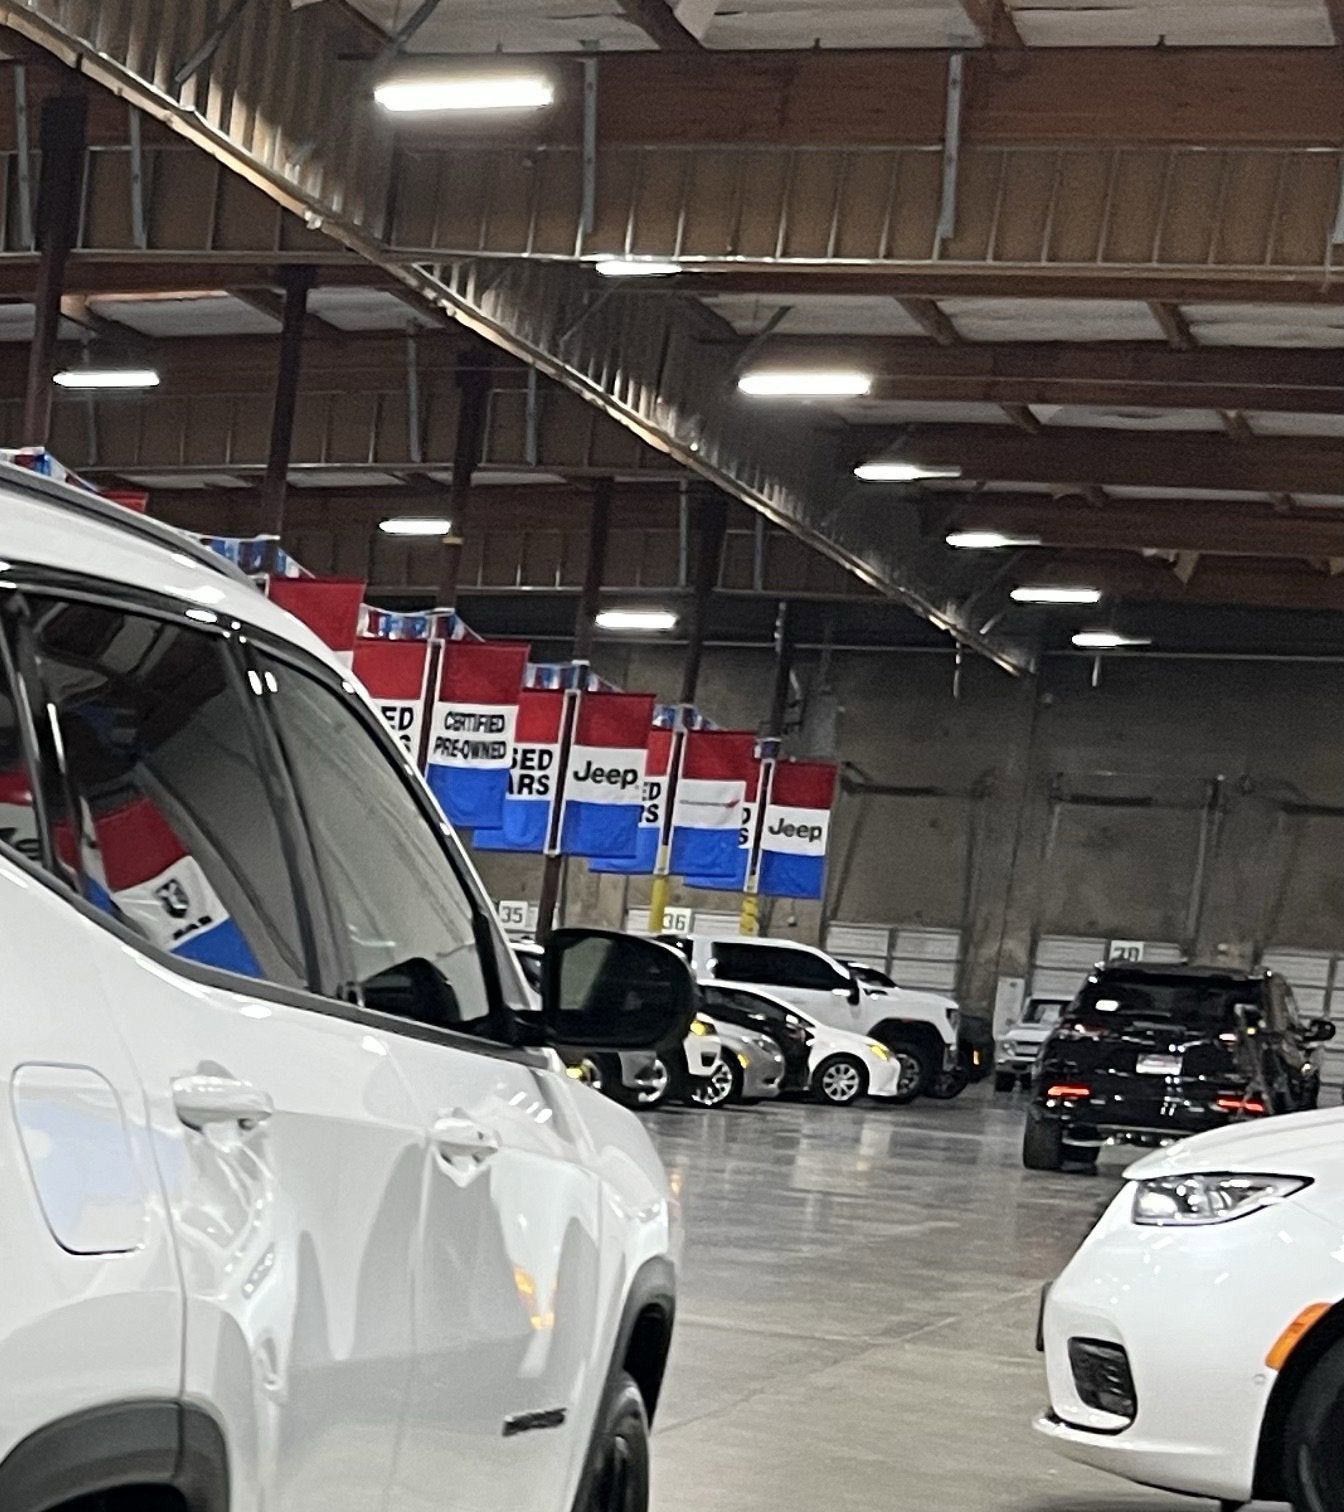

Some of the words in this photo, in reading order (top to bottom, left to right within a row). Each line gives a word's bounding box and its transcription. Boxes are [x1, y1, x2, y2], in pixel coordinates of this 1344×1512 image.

[445, 711, 506, 733] CERTIFIED
[434, 736, 507, 760] PRE-OWNED
[573, 760, 638, 790] Jeep
[768, 818, 823, 842] Jeep
[502, 906, 523, 923] 35
[664, 913, 686, 931] 36
